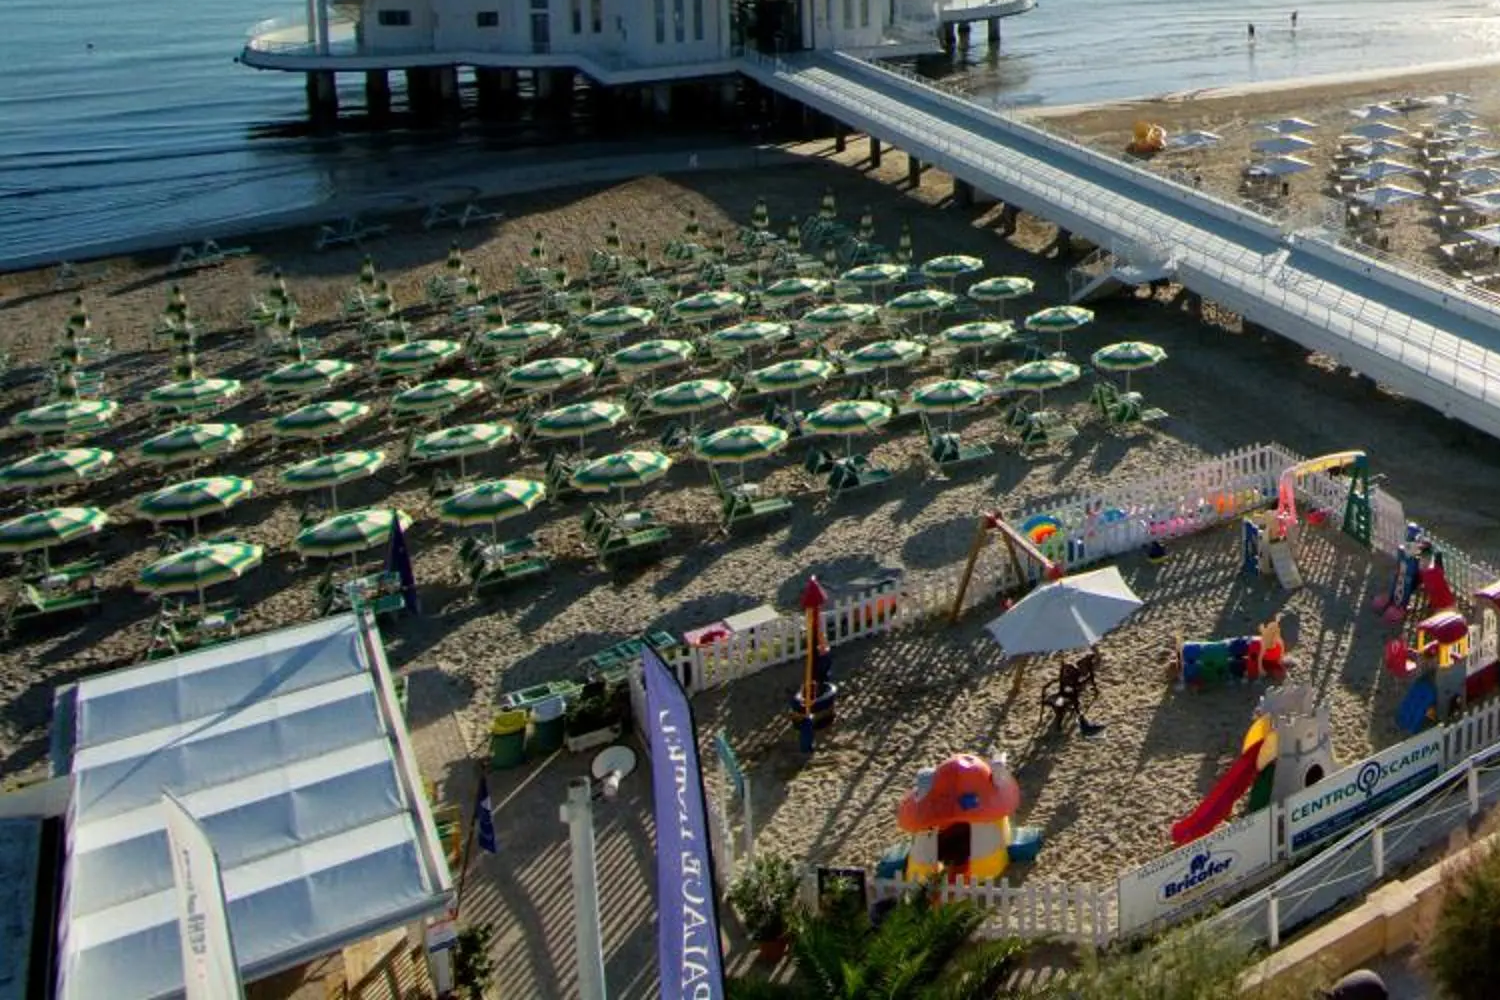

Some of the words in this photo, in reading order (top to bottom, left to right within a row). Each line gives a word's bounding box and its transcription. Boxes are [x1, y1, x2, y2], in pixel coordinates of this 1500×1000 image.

[1291, 782, 1357, 823] CENTRO
[1380, 741, 1440, 779] SCARPA
[1164, 857, 1233, 898] Bricofer
